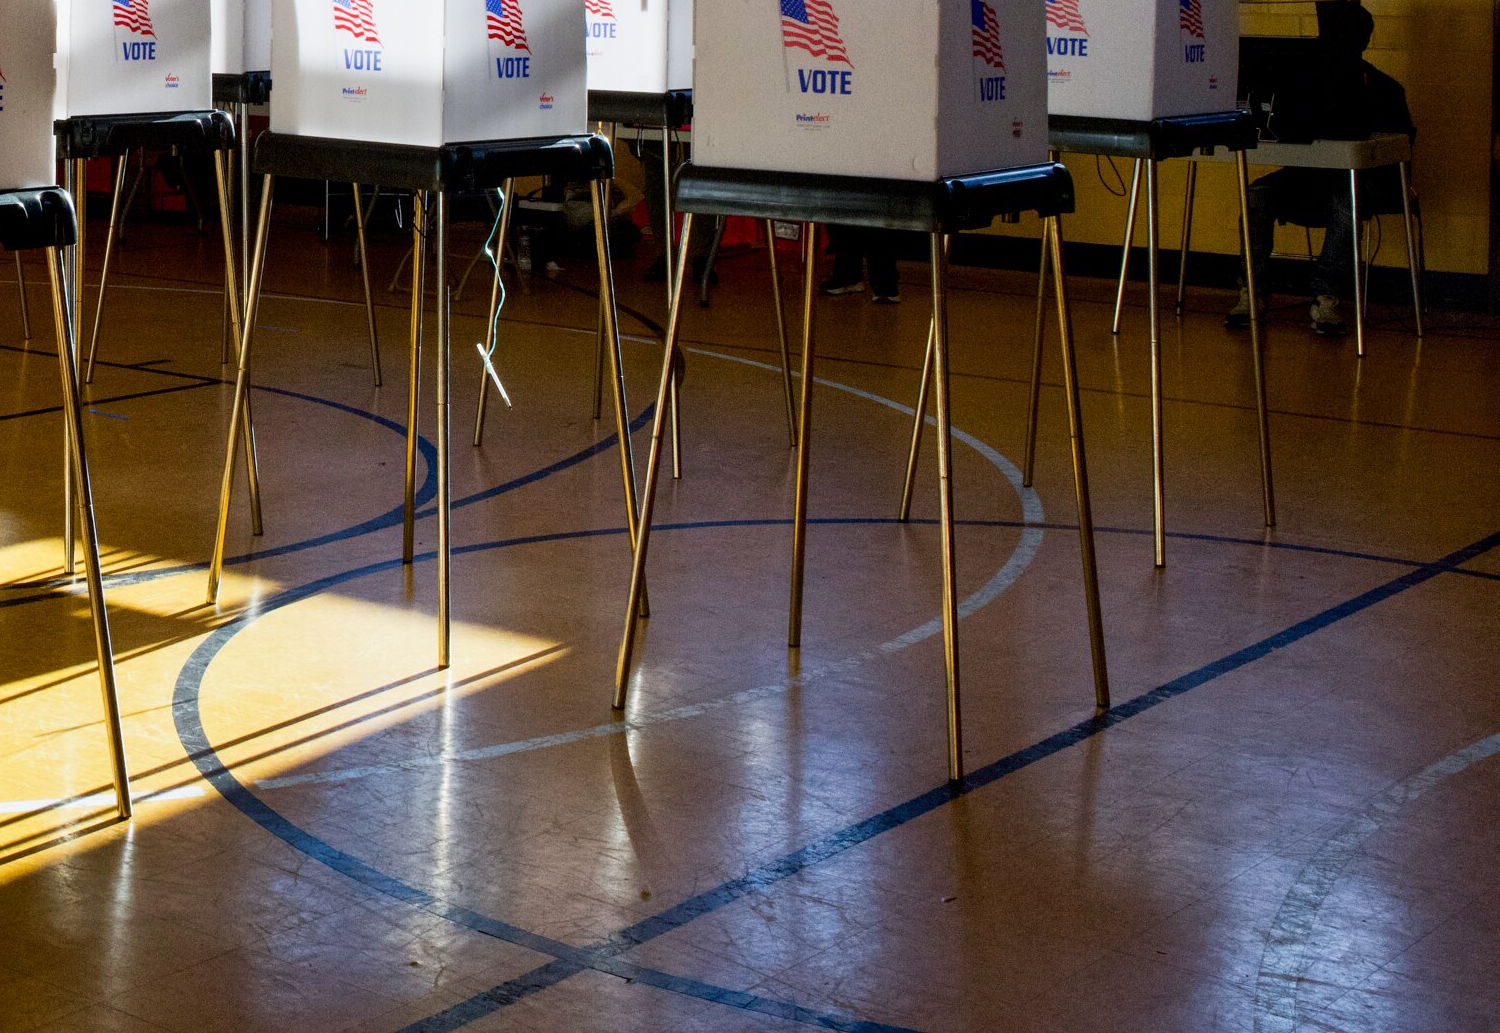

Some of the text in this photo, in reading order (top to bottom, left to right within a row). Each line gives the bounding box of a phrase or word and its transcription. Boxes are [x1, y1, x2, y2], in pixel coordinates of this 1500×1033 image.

[122, 41, 155, 61] VOTE
[1046, 37, 1088, 57] VOTE
[1185, 44, 1205, 63] VOTE
[344, 49, 382, 72] VOTE
[496, 57, 530, 79] VOTE
[797, 69, 853, 95] VOTE
[980, 77, 1006, 101] VOTE
